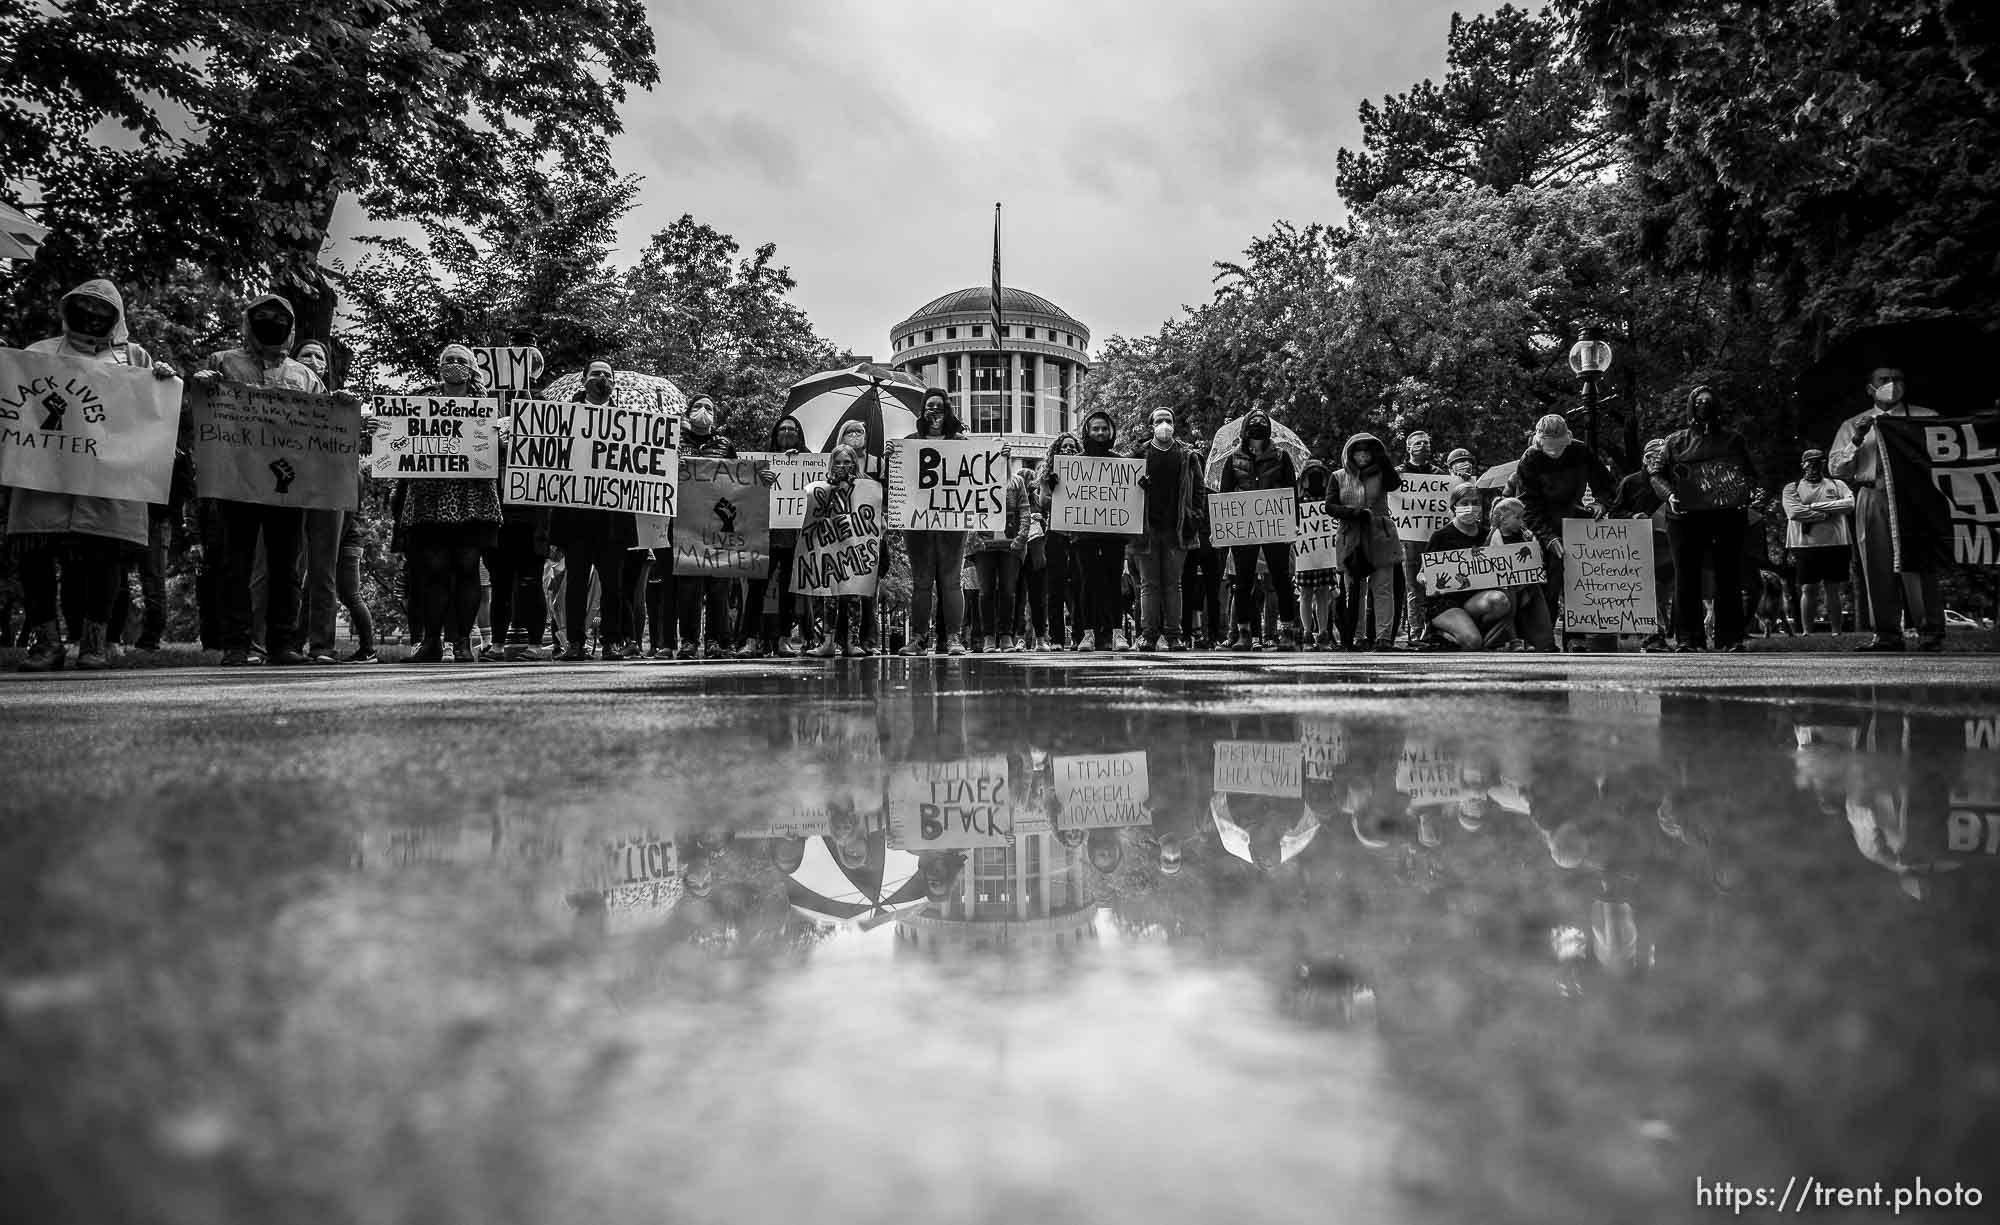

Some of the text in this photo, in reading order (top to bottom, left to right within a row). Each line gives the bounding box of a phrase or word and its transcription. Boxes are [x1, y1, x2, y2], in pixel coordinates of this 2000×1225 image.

[473, 348, 528, 389] BLM
[0, 376, 106, 423] BLACK LIVES
[374, 396, 494, 418] Public Defender
[200, 423, 252, 446] Black
[261, 427, 303, 450] Lives
[407, 417, 464, 439] BLACK
[513, 403, 678, 448] KNOW JUSTICE
[2, 428, 97, 456] MATTER
[412, 437, 461, 454] LIVES
[398, 454, 470, 472] MATTER
[509, 436, 574, 470] KNOW
[592, 440, 666, 476] PEACE
[919, 448, 1001, 489] BLACK
[1059, 459, 1143, 487] HOW MANY
[1400, 480, 1450, 492] BLACK
[776, 497, 806, 516] TTE
[813, 483, 855, 518] SAY
[929, 485, 1003, 514] LIVES
[1211, 500, 1248, 519] THEY
[1300, 502, 1328, 519] LAC
[1401, 498, 1447, 512] LIVES
[911, 509, 989, 529] MATTER
[1064, 506, 1130, 527] FILMED
[1391, 516, 1451, 529] MATTER
[802, 504, 880, 552] THEIR
[1214, 518, 1287, 540] BREATHE
[1586, 525, 1627, 540] UTAH
[1293, 534, 1337, 557] ATT
[1572, 544, 1641, 560] Juvenile
[1953, 523, 2000, 565] M
[675, 544, 760, 571] MATTER
[798, 539, 879, 589] NAMES
[1423, 550, 1466, 567] BLACK
[1458, 555, 1513, 577] CHILDREN
[1496, 566, 1546, 586] MATTER
[1582, 561, 1643, 577] Defender
[1574, 578, 1642, 600] Attorneys
[1583, 593, 1640, 609] Support
